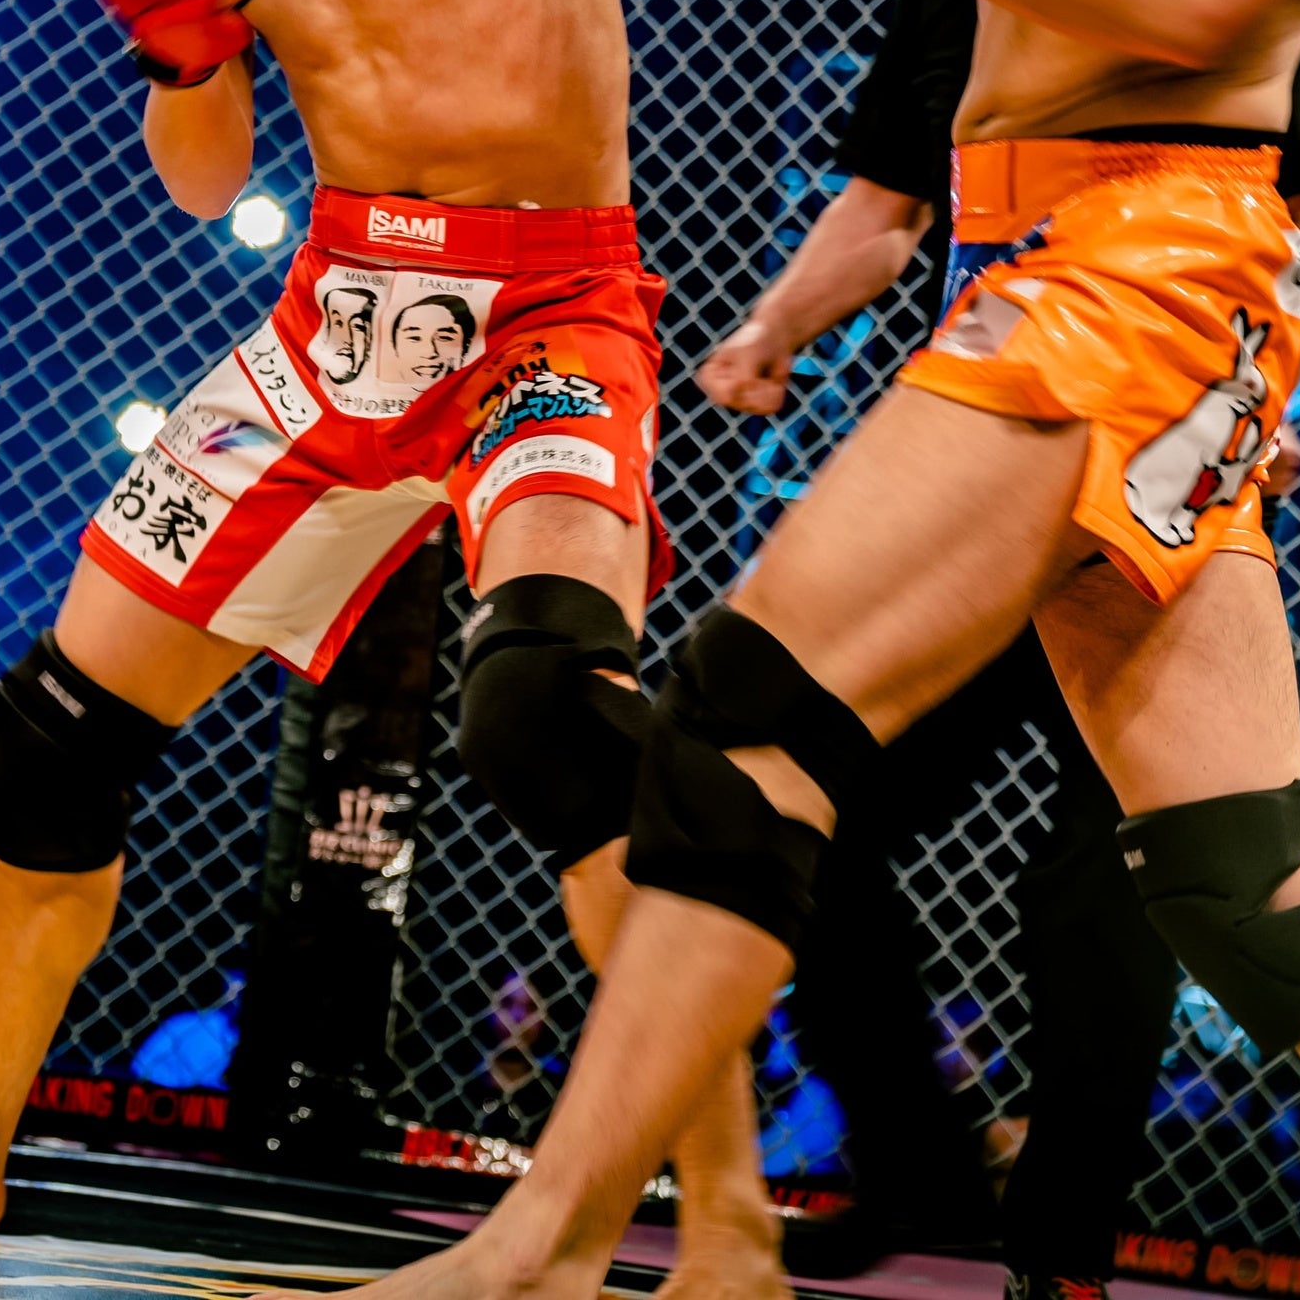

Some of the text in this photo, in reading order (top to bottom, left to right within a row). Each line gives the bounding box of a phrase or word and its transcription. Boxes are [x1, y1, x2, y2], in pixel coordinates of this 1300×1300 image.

[367, 205, 447, 244] ISAMI
[343, 271, 388, 288] MANABU
[418, 276, 475, 293] TAKUMI
[124, 1082, 230, 1132] DOWN
